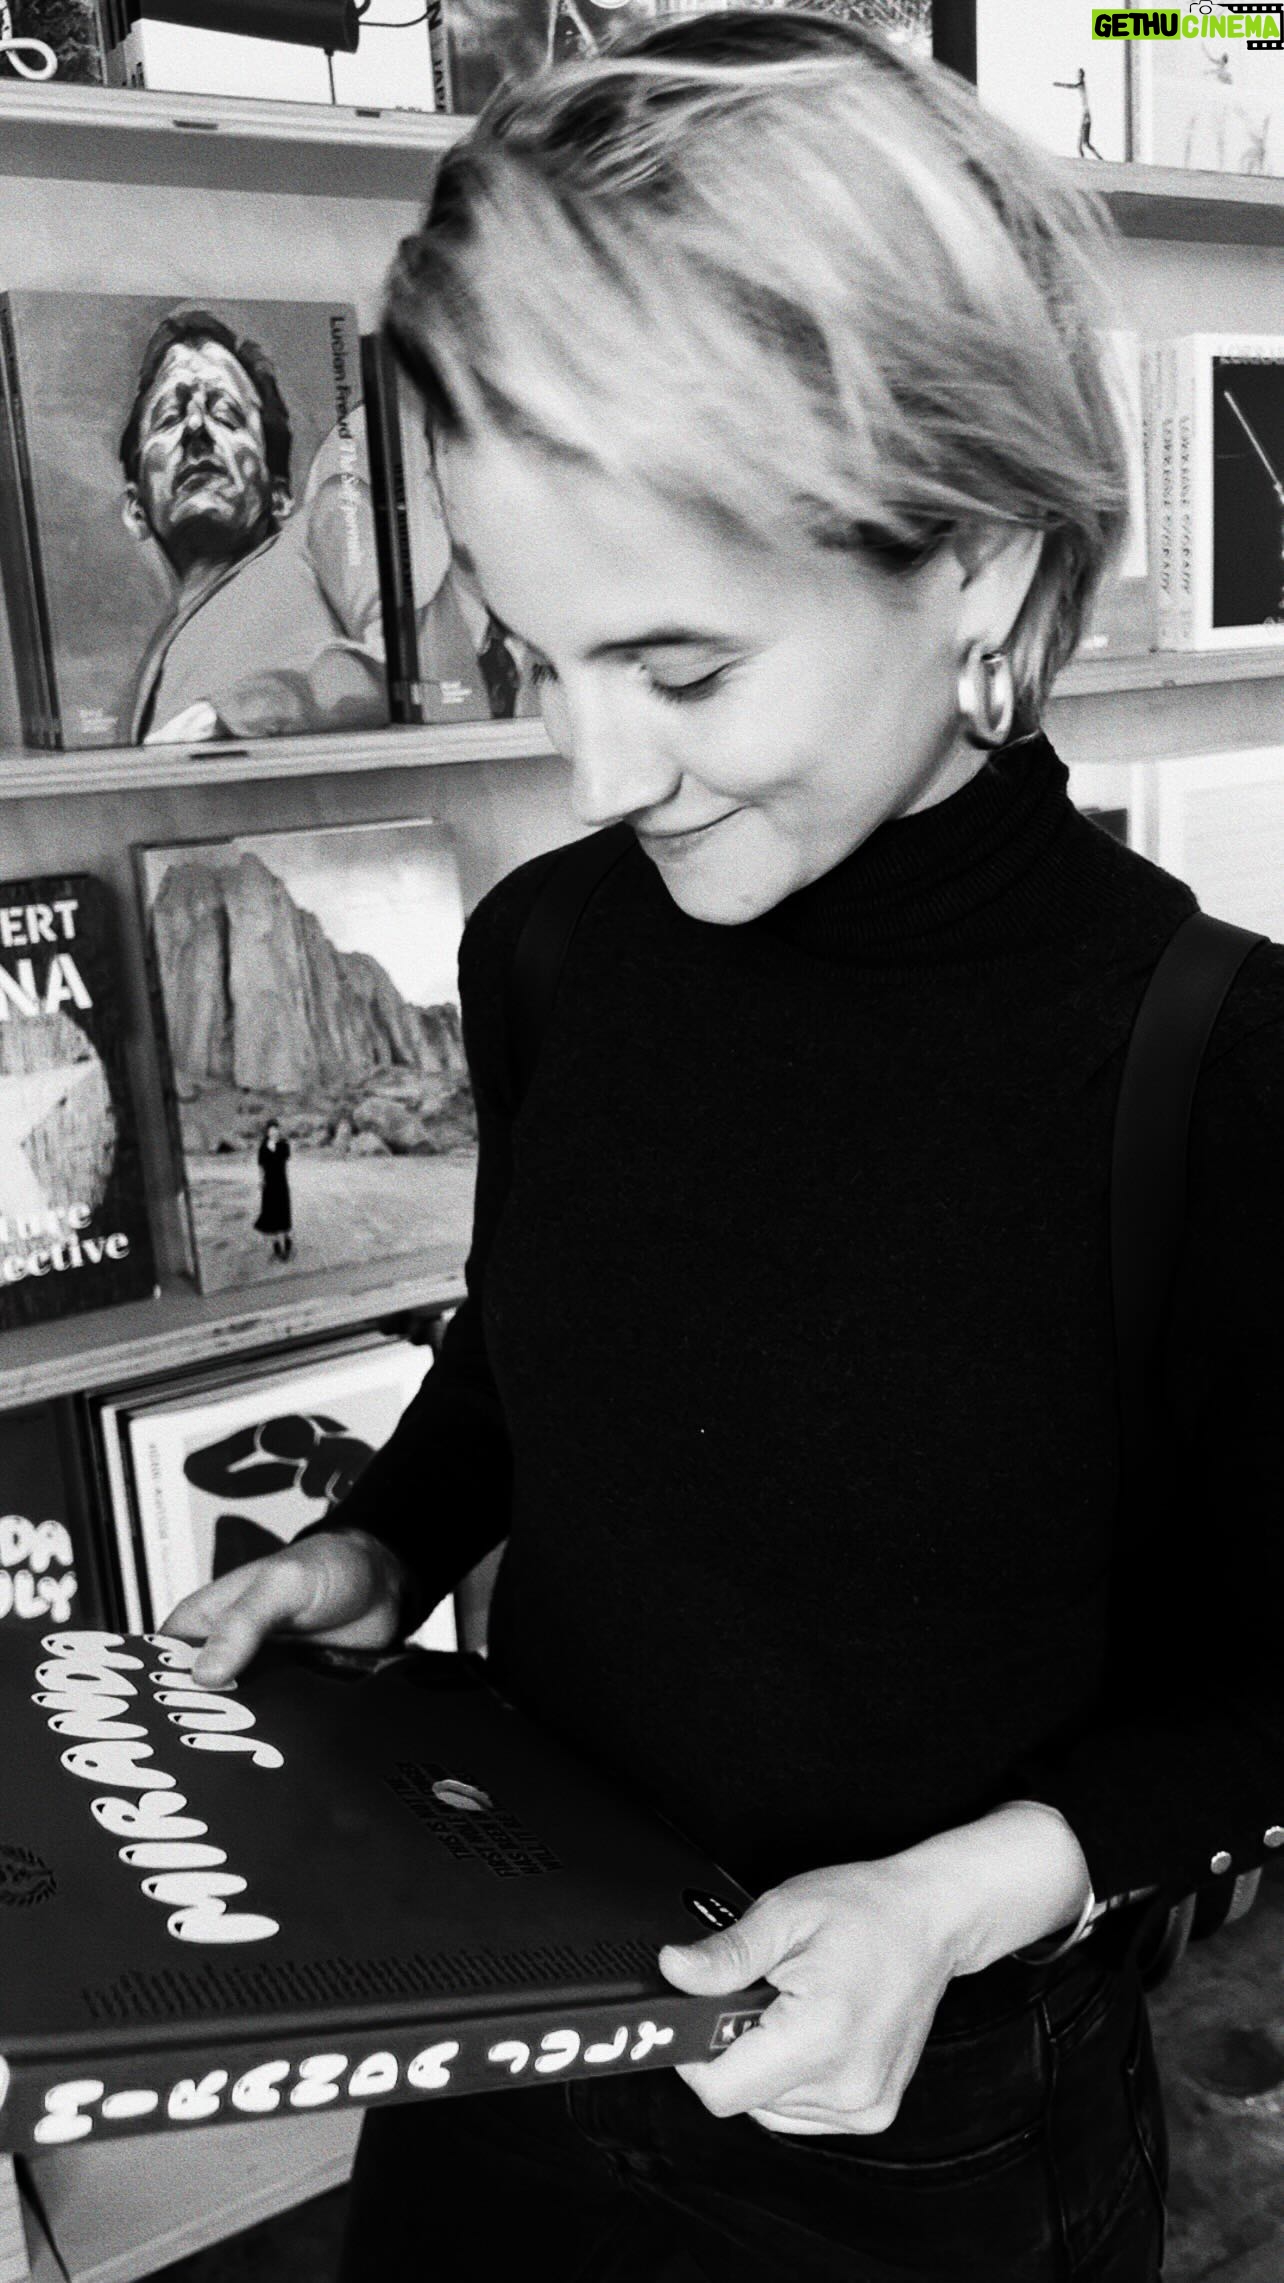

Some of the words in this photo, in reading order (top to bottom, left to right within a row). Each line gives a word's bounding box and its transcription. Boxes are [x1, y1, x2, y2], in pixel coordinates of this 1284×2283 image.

[330, 316, 348, 381] Lucian
[336, 385, 353, 439] Freud
[0, 1232, 130, 1288] ective
[31, 1630, 280, 1944] MIRANDA
[34, 2041, 459, 2144] MIRANDA
[487, 2020, 674, 2074] JULY
